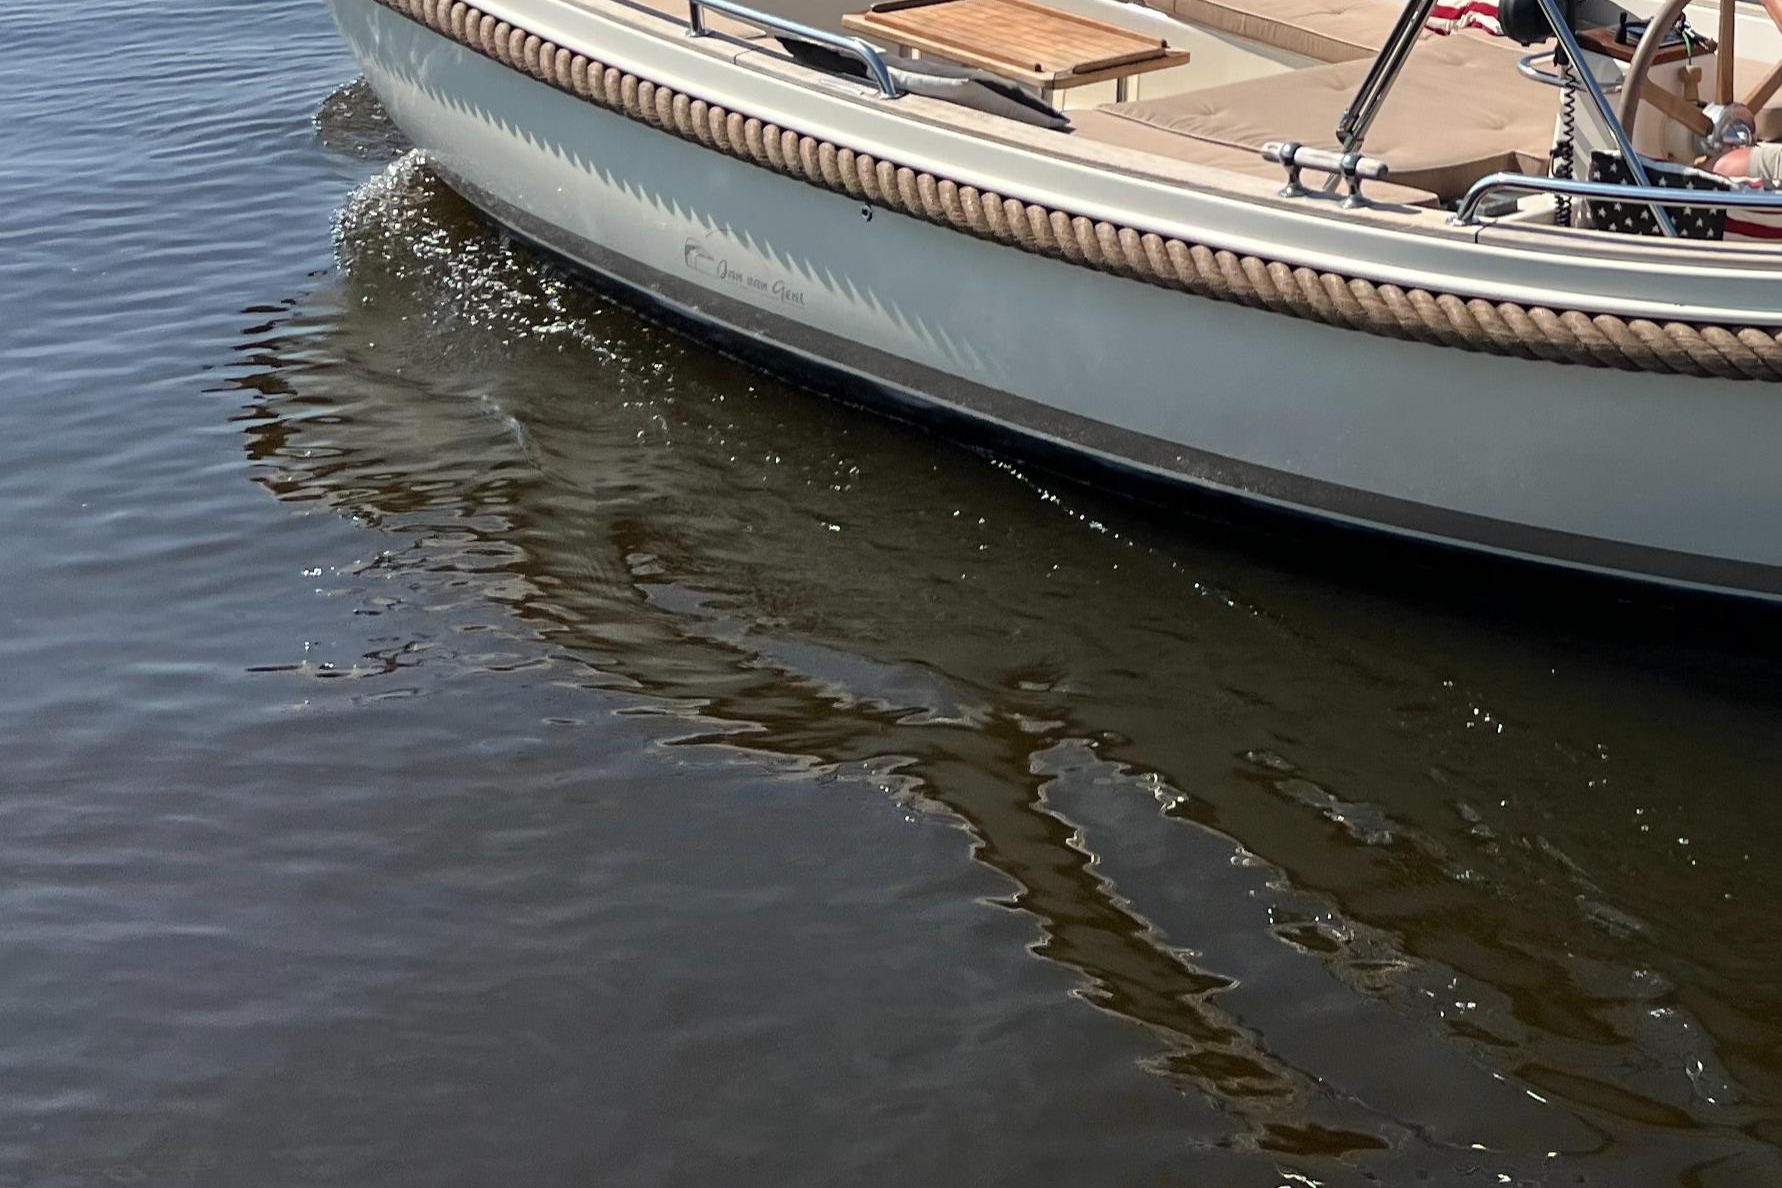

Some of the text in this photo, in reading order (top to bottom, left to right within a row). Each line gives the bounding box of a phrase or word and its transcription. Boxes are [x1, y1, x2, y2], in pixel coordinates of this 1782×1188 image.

[716, 259, 806, 305] Jan van Gent
